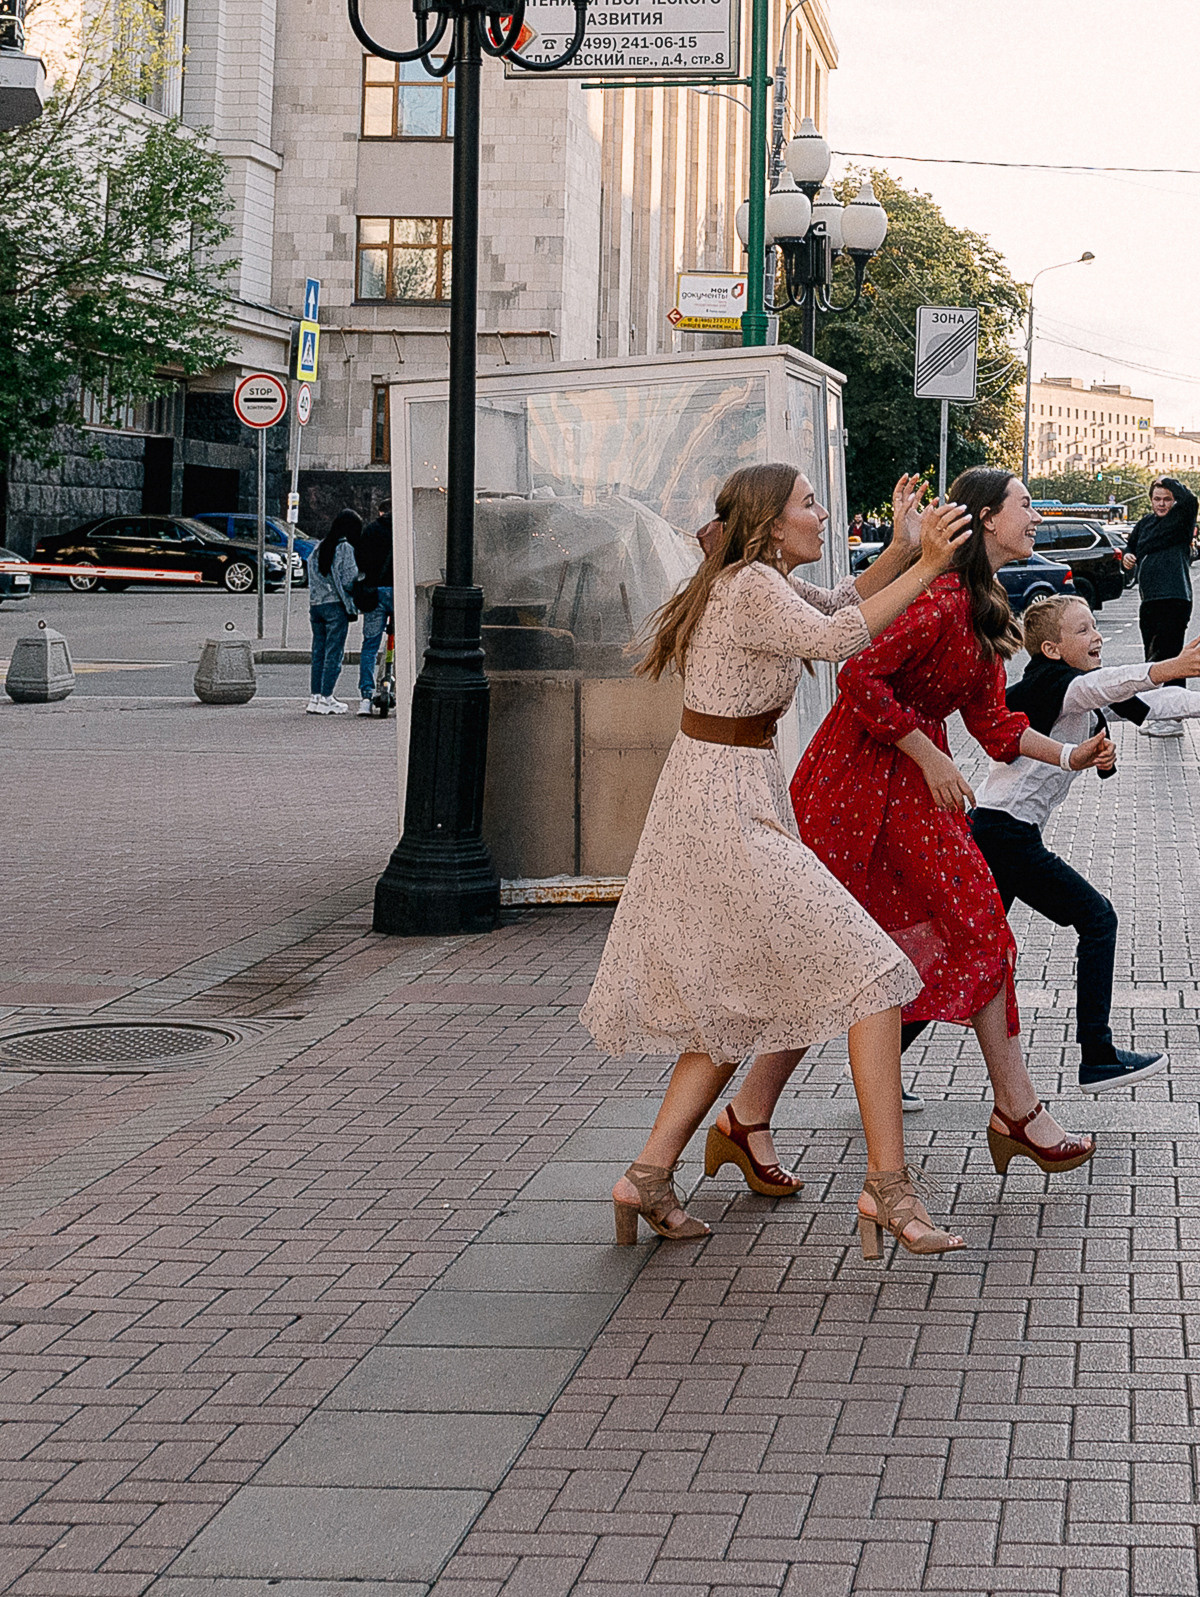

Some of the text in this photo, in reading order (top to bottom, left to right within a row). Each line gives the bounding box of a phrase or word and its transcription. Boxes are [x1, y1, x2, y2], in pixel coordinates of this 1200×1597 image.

[586, 12, 663, 26] АЗВИТИЯ
[564, 37, 574, 49] 8
[620, 36, 697, 49] 241-06-15
[931, 312, 965, 324] ЗОНА
[249, 388, 273, 396] STOP
